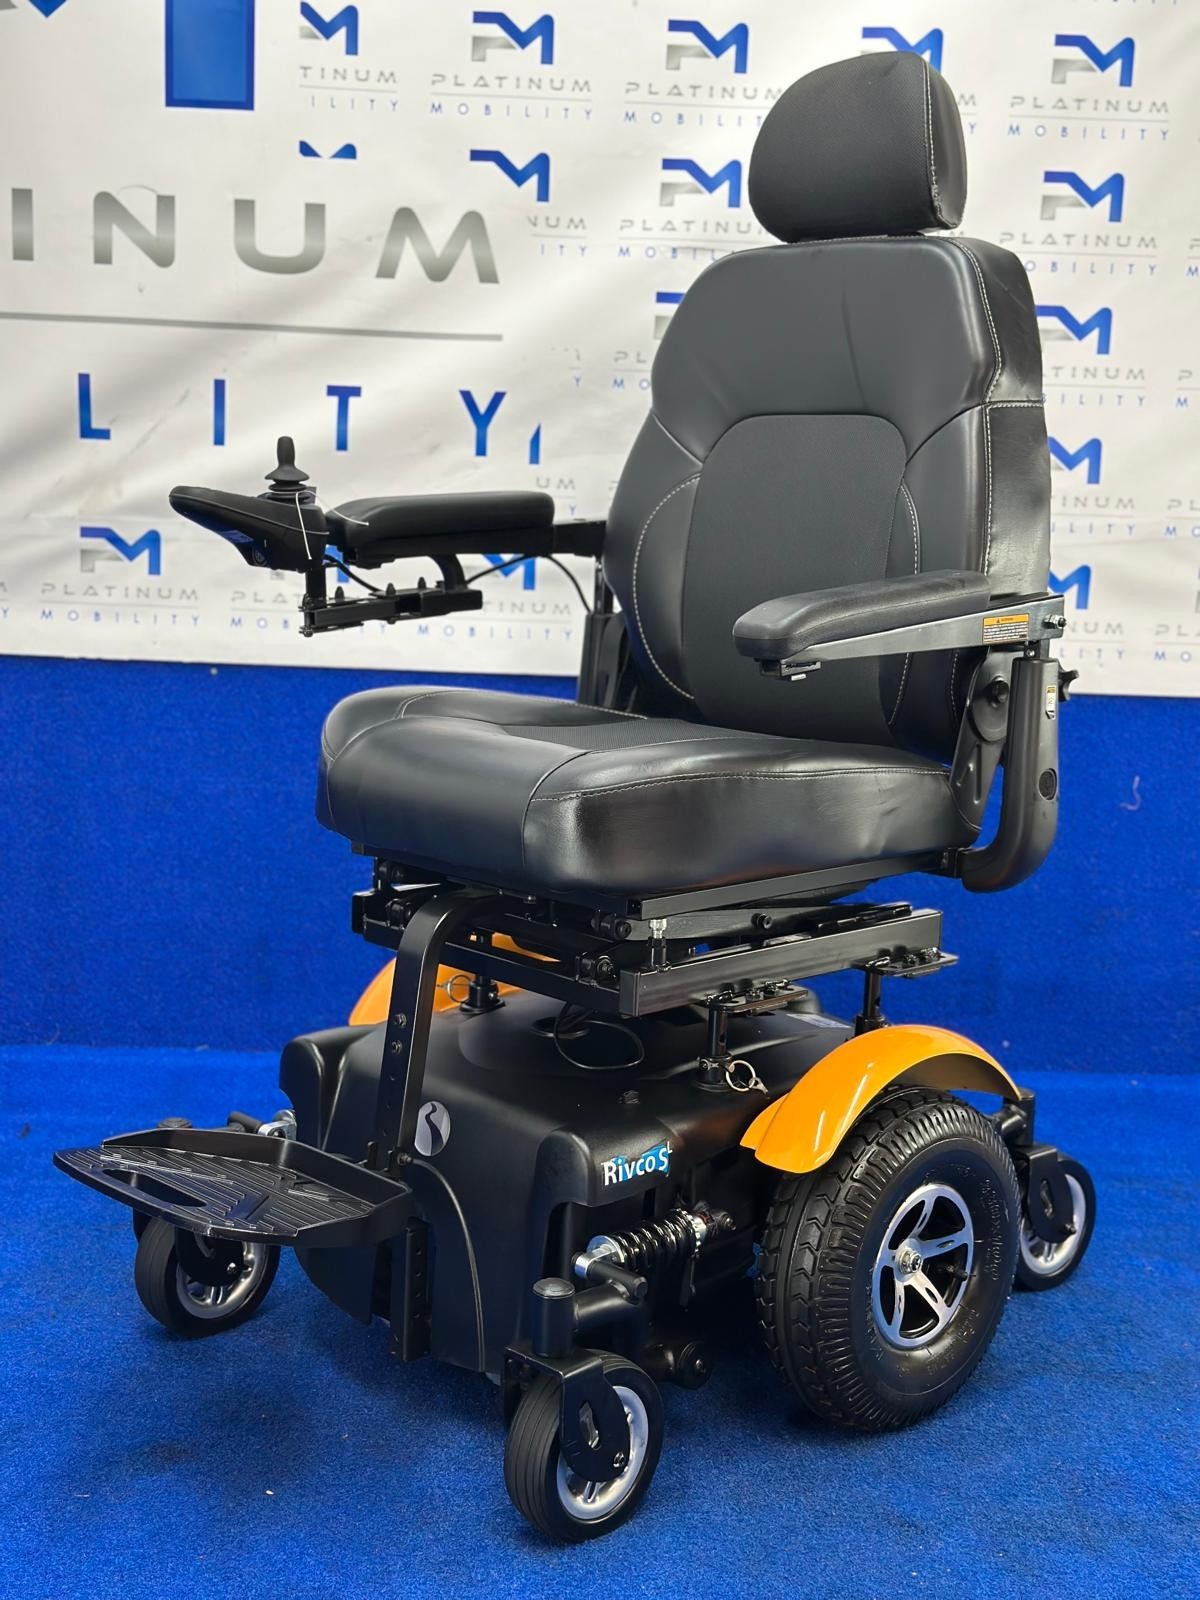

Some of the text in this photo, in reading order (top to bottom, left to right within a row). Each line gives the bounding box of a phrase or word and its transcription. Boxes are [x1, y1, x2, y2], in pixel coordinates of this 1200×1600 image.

[299, 65, 397, 83] TINUM
[431, 73, 592, 93] PLATINUM
[310, 94, 399, 113] ILITY
[430, 102, 592, 120] MOBILITY
[1009, 95, 1169, 114] PLATINUM
[624, 111, 764, 127] MOBILIT
[1007, 123, 1169, 141] MOBILITY
[11, 187, 500, 284] INUM
[619, 219, 769, 235] PLATINU
[1000, 232, 1158, 250] PLATINUM
[618, 246, 719, 261] MOBIL
[1025, 260, 1157, 276] OBILITY
[1051, 365, 1146, 381] TINUM
[78, 373, 507, 458] LITY
[41, 583, 199, 600] PLATINUM
[40, 608, 200, 626] MOBILITY
[417, 625, 572, 640] MOBILITY
